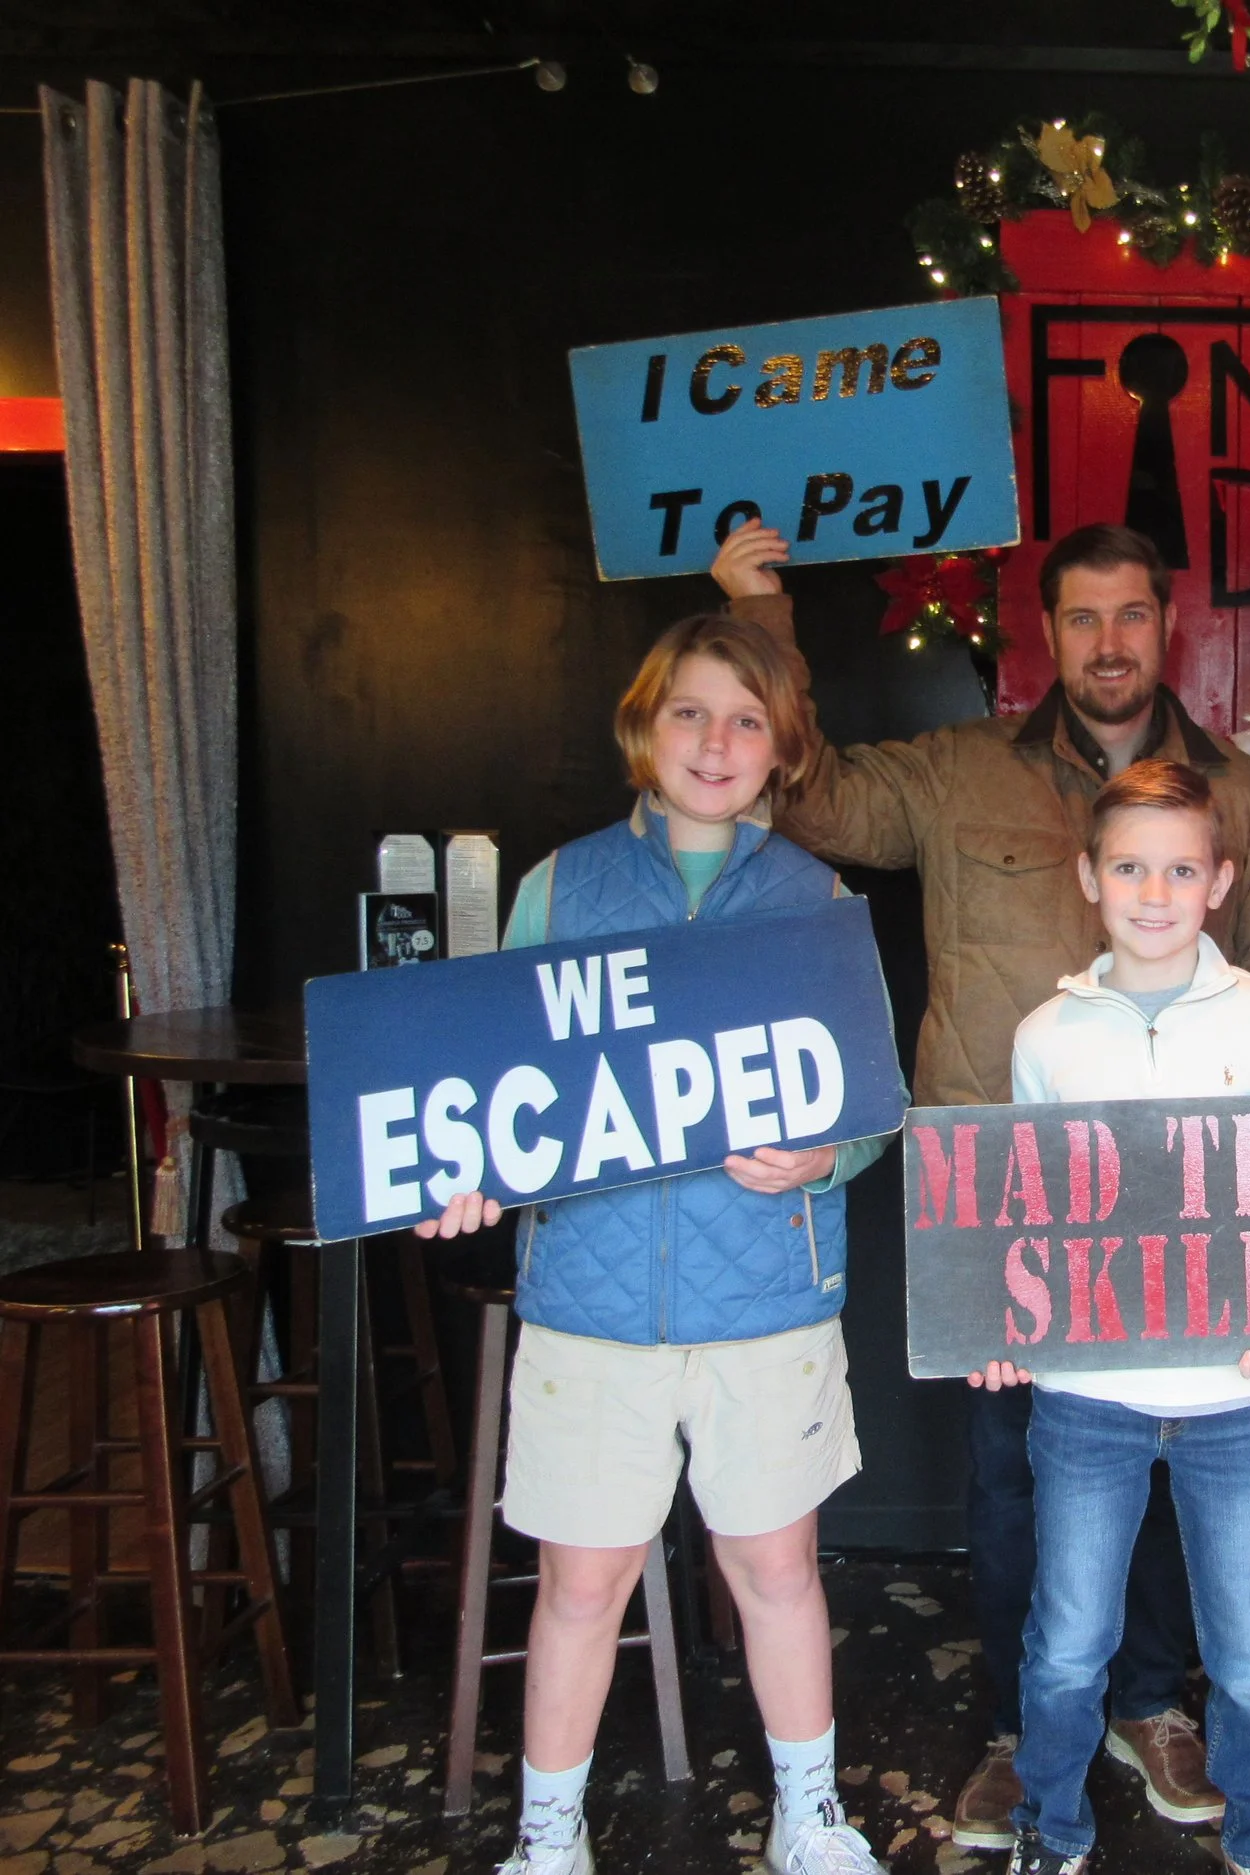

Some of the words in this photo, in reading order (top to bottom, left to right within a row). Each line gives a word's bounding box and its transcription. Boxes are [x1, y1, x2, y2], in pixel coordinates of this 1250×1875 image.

[640, 354, 667, 423] I
[689, 335, 942, 415] Came
[649, 488, 763, 556] To
[796, 471, 973, 549] Pay
[536, 947, 656, 1042] WE
[358, 1016, 846, 1223] ESCAPED
[911, 1119, 1122, 1230] MAD
